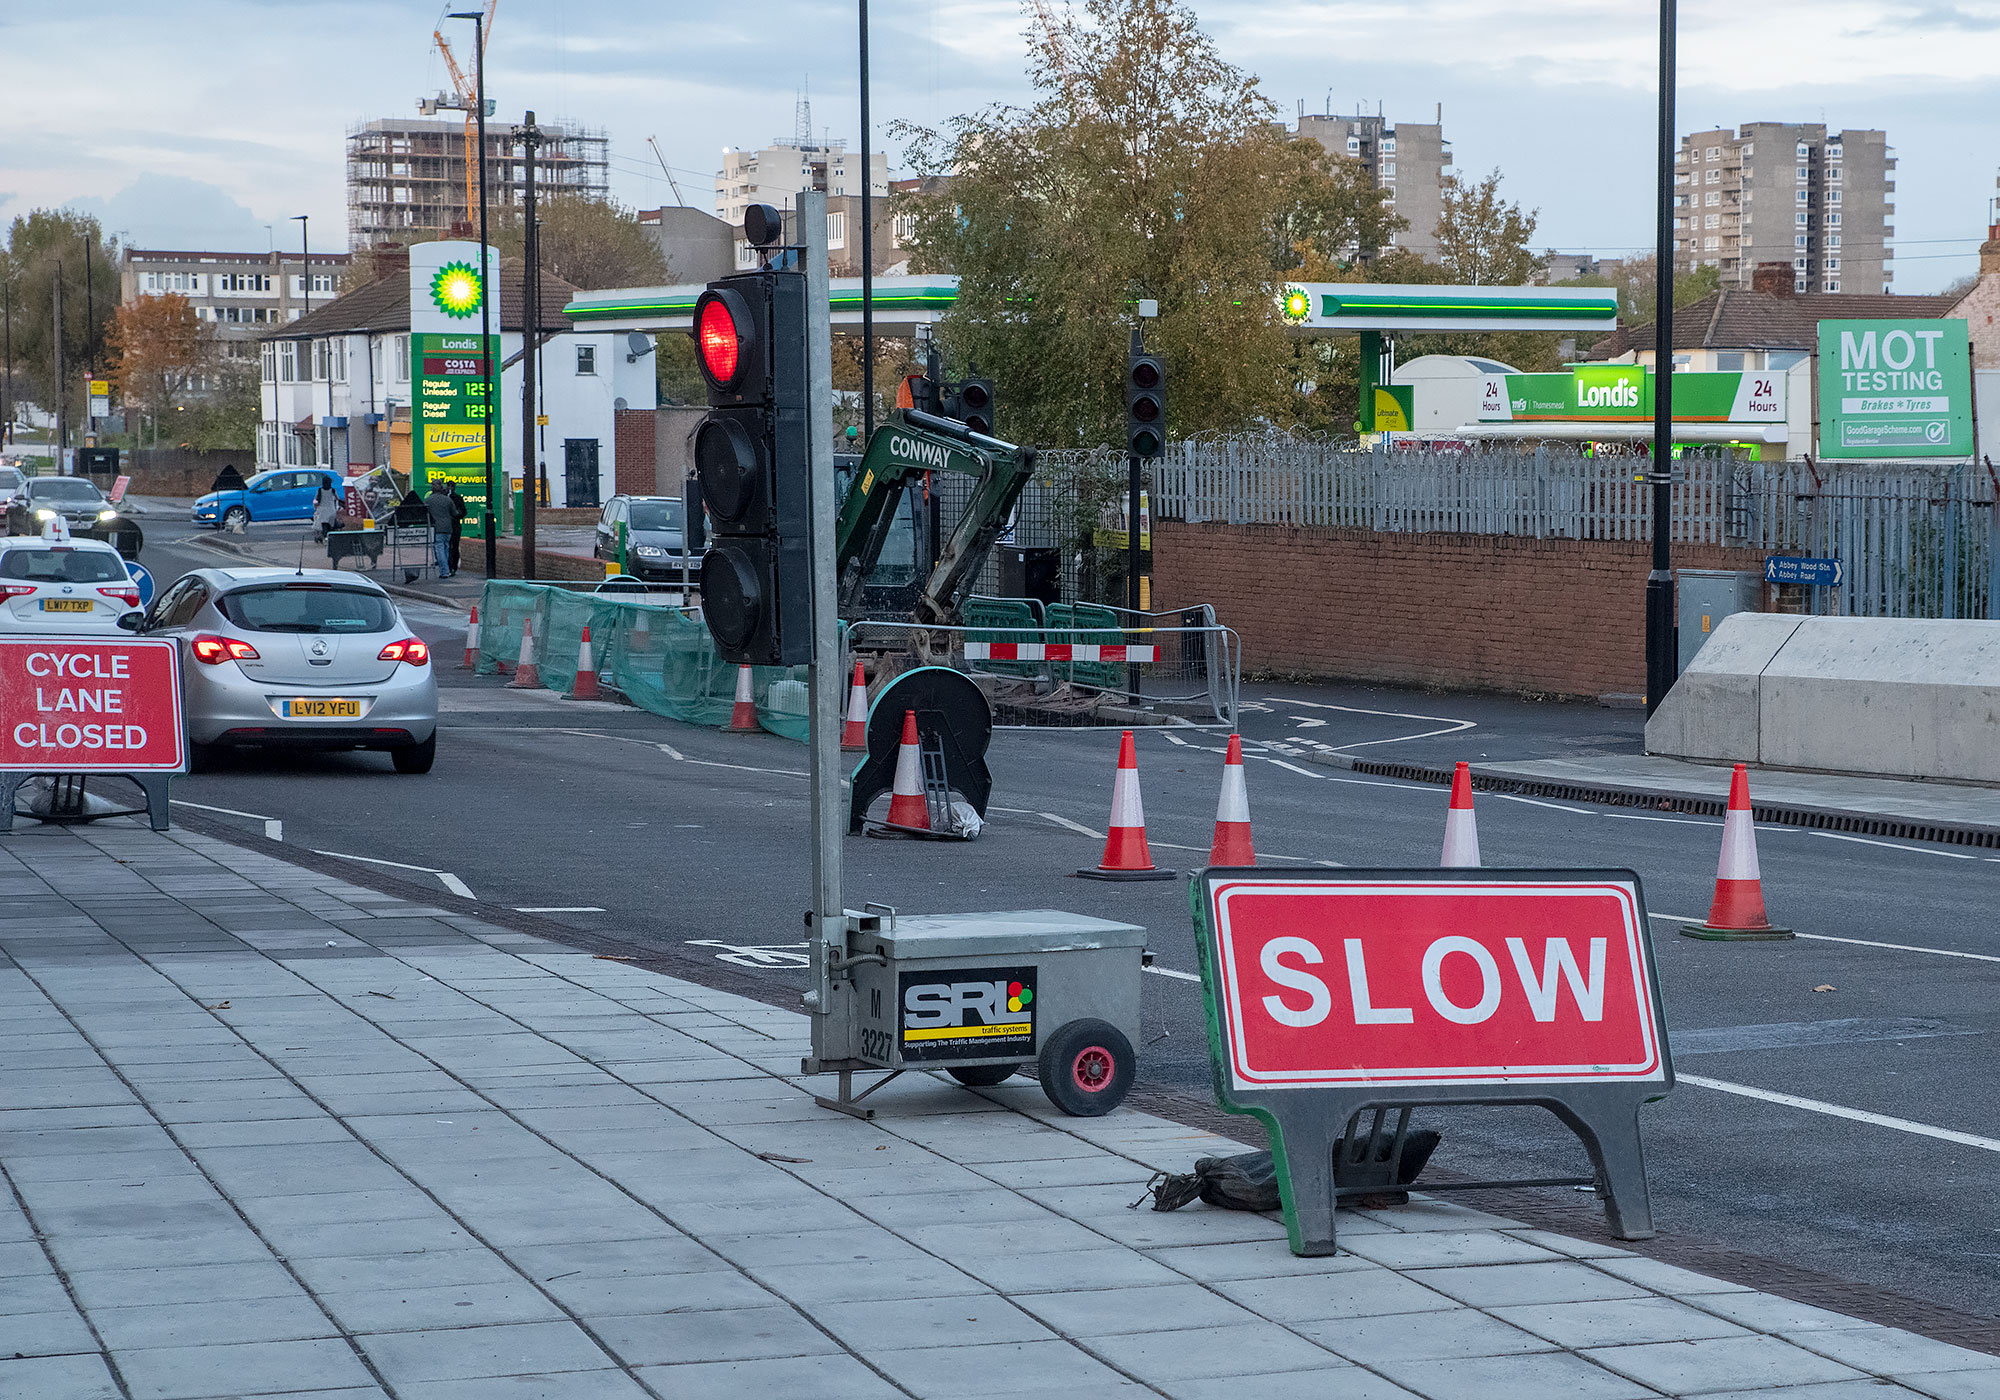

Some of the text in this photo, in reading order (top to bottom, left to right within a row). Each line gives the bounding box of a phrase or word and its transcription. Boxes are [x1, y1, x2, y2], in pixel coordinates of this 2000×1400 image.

[442, 338, 478, 349] Londis
[1841, 330, 1944, 370] MOT
[445, 360, 476, 368] COSTA
[423, 380, 450, 388] Regular
[1841, 371, 1943, 391] TESTING
[423, 388, 457, 396] Unleaded
[1485, 381, 1498, 398] 24
[1577, 378, 1639, 408] Londis
[1754, 380, 1772, 397] 24
[423, 401, 451, 410] Regular
[1482, 400, 1501, 411] Hours
[1748, 400, 1777, 412] Hours
[1861, 399, 1932, 412] Brakes Tyres
[423, 410, 446, 418] Diesel
[1846, 424, 1923, 437] GoodGarageScheme.com
[890, 435, 951, 468] CONWAY
[52, 523, 62, 533] L
[1778, 562, 1798, 571] Abbey
[1800, 562, 1817, 571] Wood
[1778, 570, 1816, 580] Abbey Road
[47, 600, 89, 610] LW17 TXP
[26, 652, 131, 679] CYCLE
[36, 687, 123, 713] LANE
[295, 703, 356, 715] LV12 YFU
[13, 722, 148, 749] CLOSED
[1259, 935, 1608, 1028] SLOW
[871, 988, 881, 1019] M
[904, 980, 1032, 1029] SRL
[982, 1024, 1028, 1035] traffic systems
[861, 1027, 893, 1062] 3227
[904, 1034, 1031, 1050] Supporting The Traffic Management Industry
